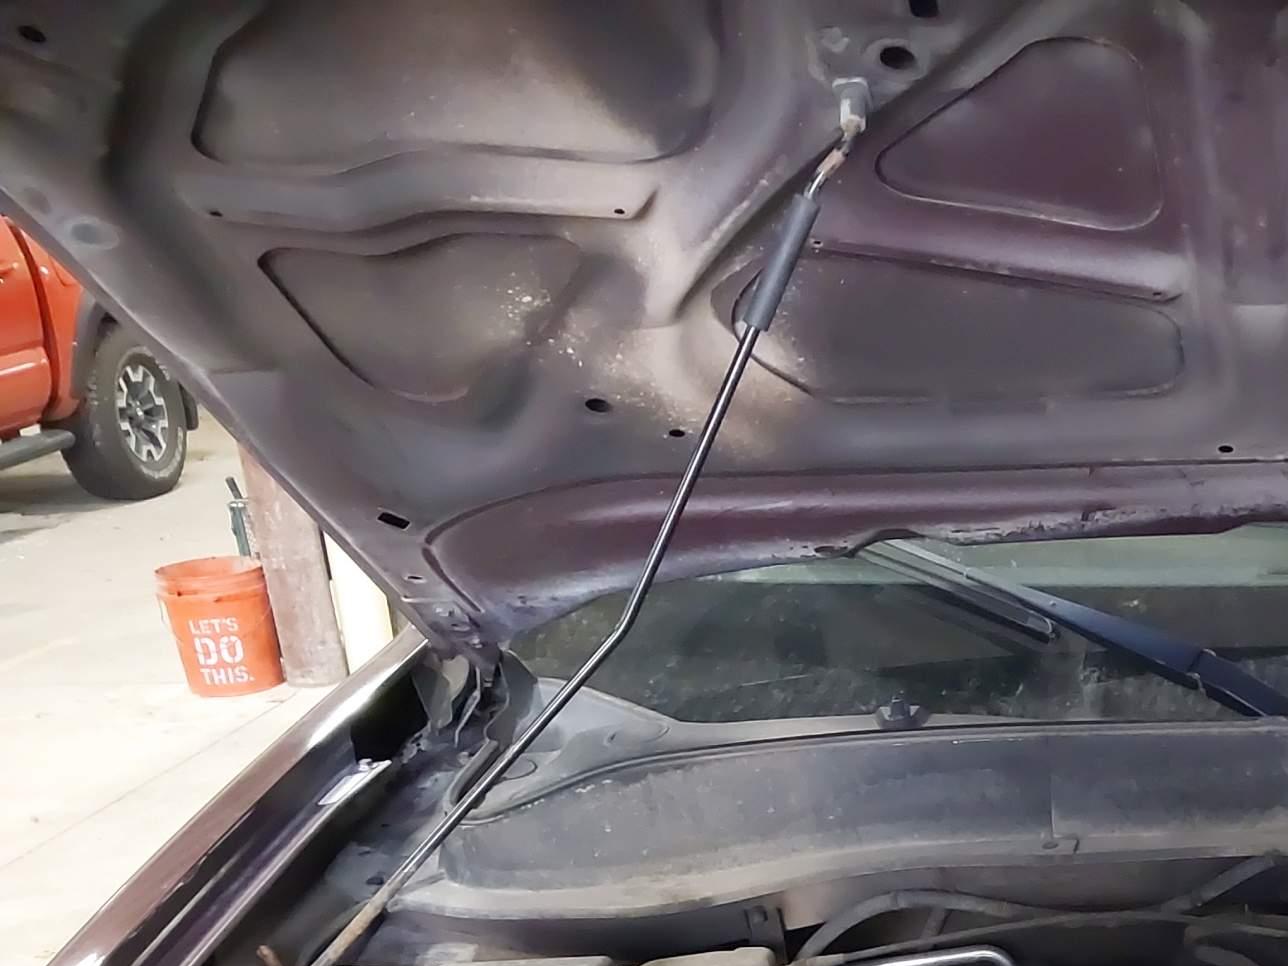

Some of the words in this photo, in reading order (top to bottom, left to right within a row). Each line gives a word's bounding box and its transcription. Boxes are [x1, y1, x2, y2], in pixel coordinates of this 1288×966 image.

[189, 617, 238, 634] LET'S
[194, 636, 244, 666] DO
[200, 666, 255, 685] THIS.
